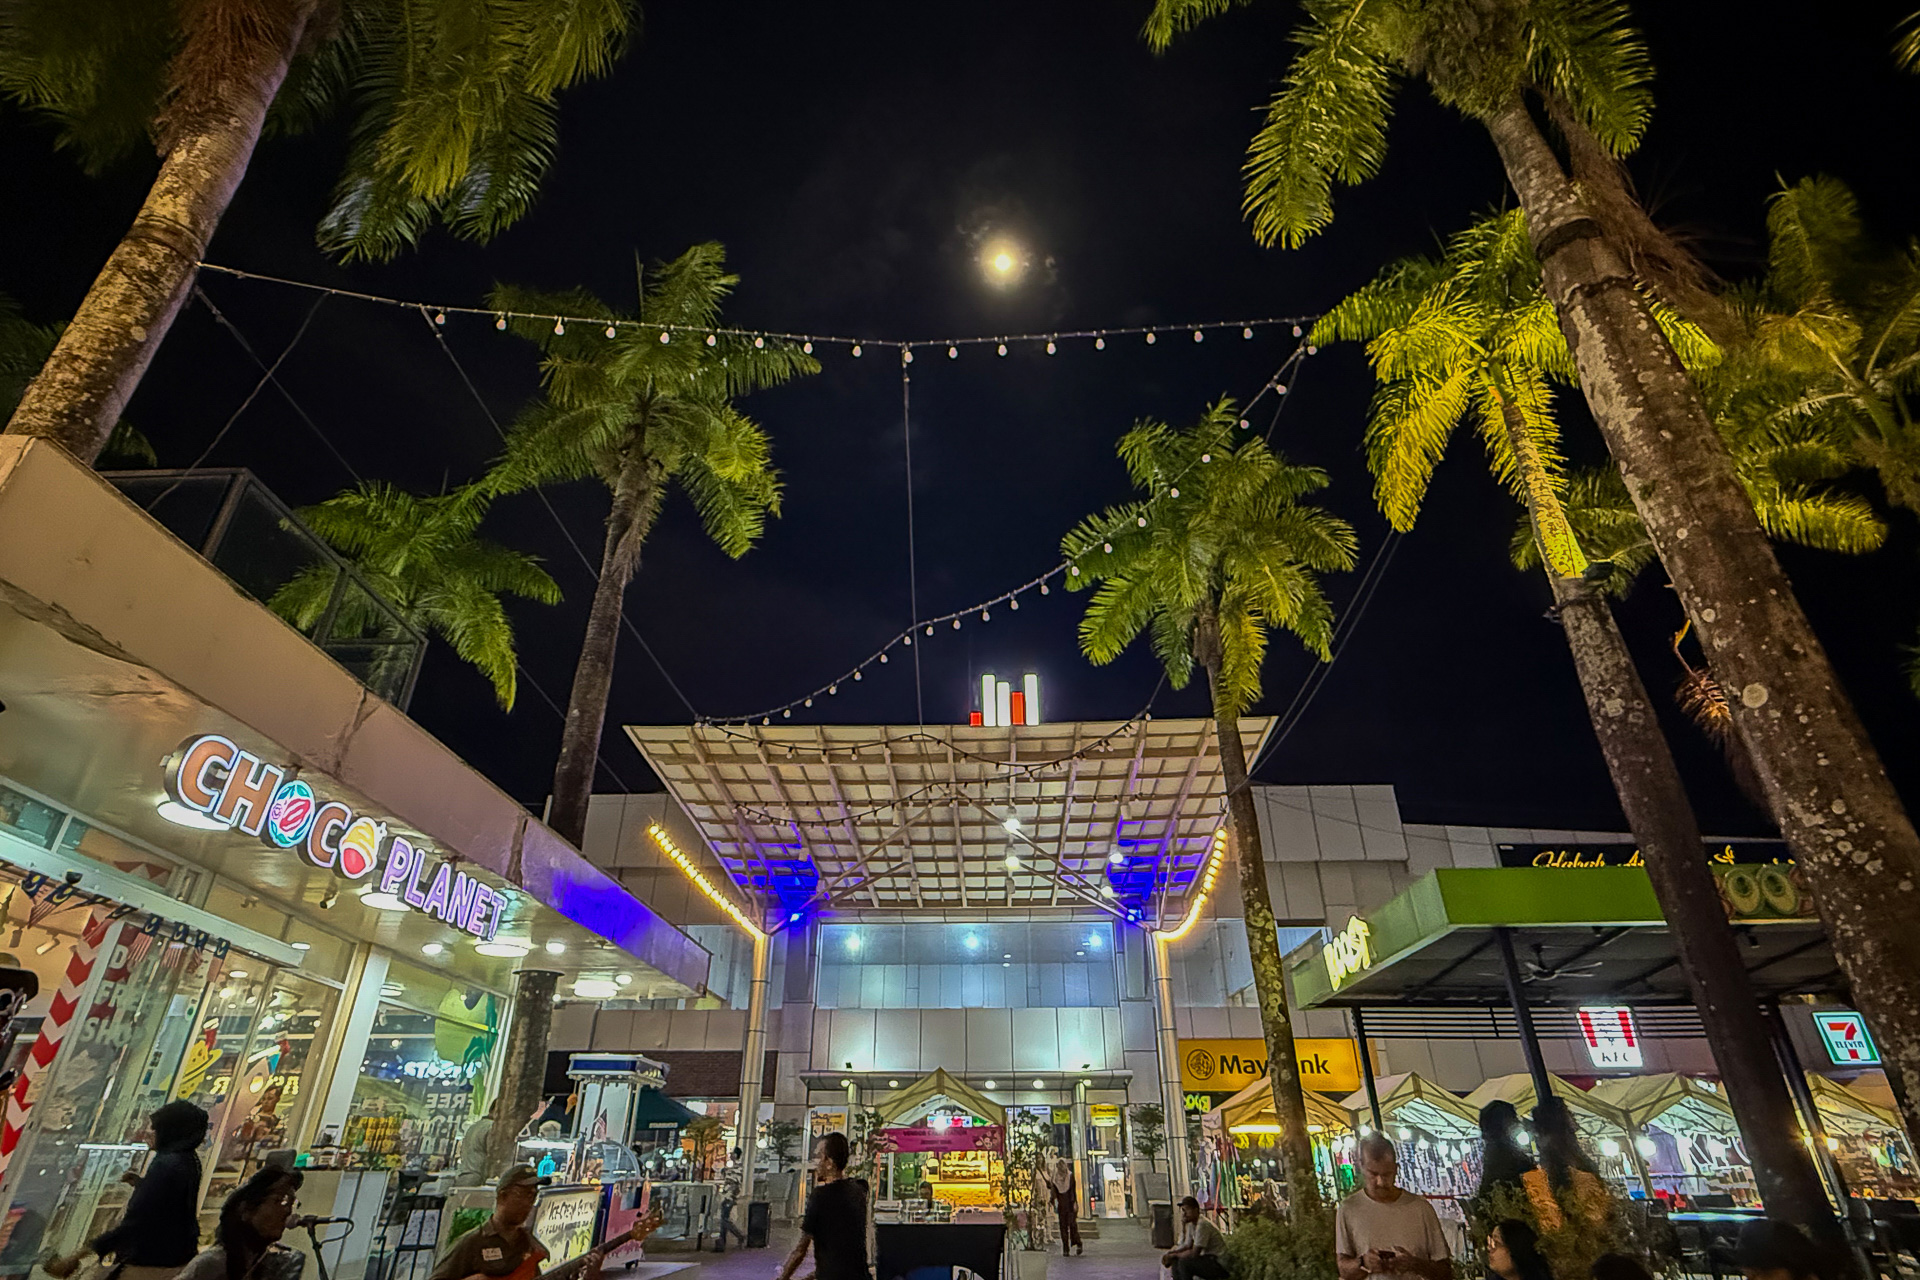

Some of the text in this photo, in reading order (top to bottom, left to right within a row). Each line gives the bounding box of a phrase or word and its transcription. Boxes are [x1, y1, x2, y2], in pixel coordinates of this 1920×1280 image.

[177, 735, 507, 941] CHOCO PLANET
[1219, 1053, 1331, 1080] Maynk
